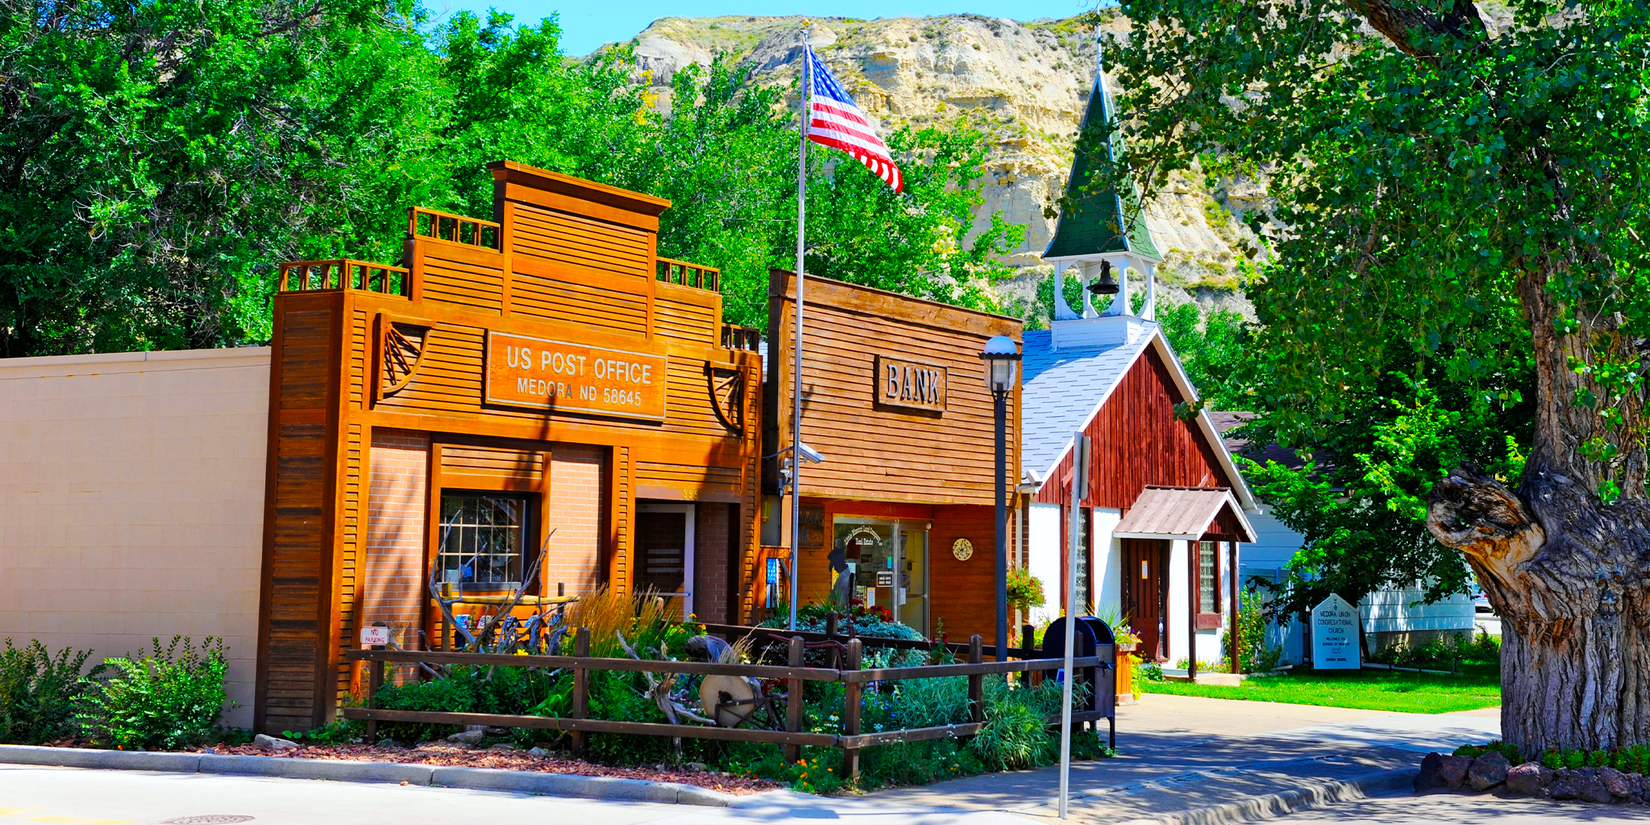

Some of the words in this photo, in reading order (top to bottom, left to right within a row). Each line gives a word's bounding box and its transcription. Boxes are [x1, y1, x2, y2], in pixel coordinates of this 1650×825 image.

[507, 345, 532, 370] US
[541, 350, 587, 376] POST
[594, 357, 652, 385] OFFICE
[887, 364, 941, 404] BANK
[517, 377, 573, 400] MEDORA
[579, 385, 597, 401] ND
[603, 387, 641, 407] 58645
